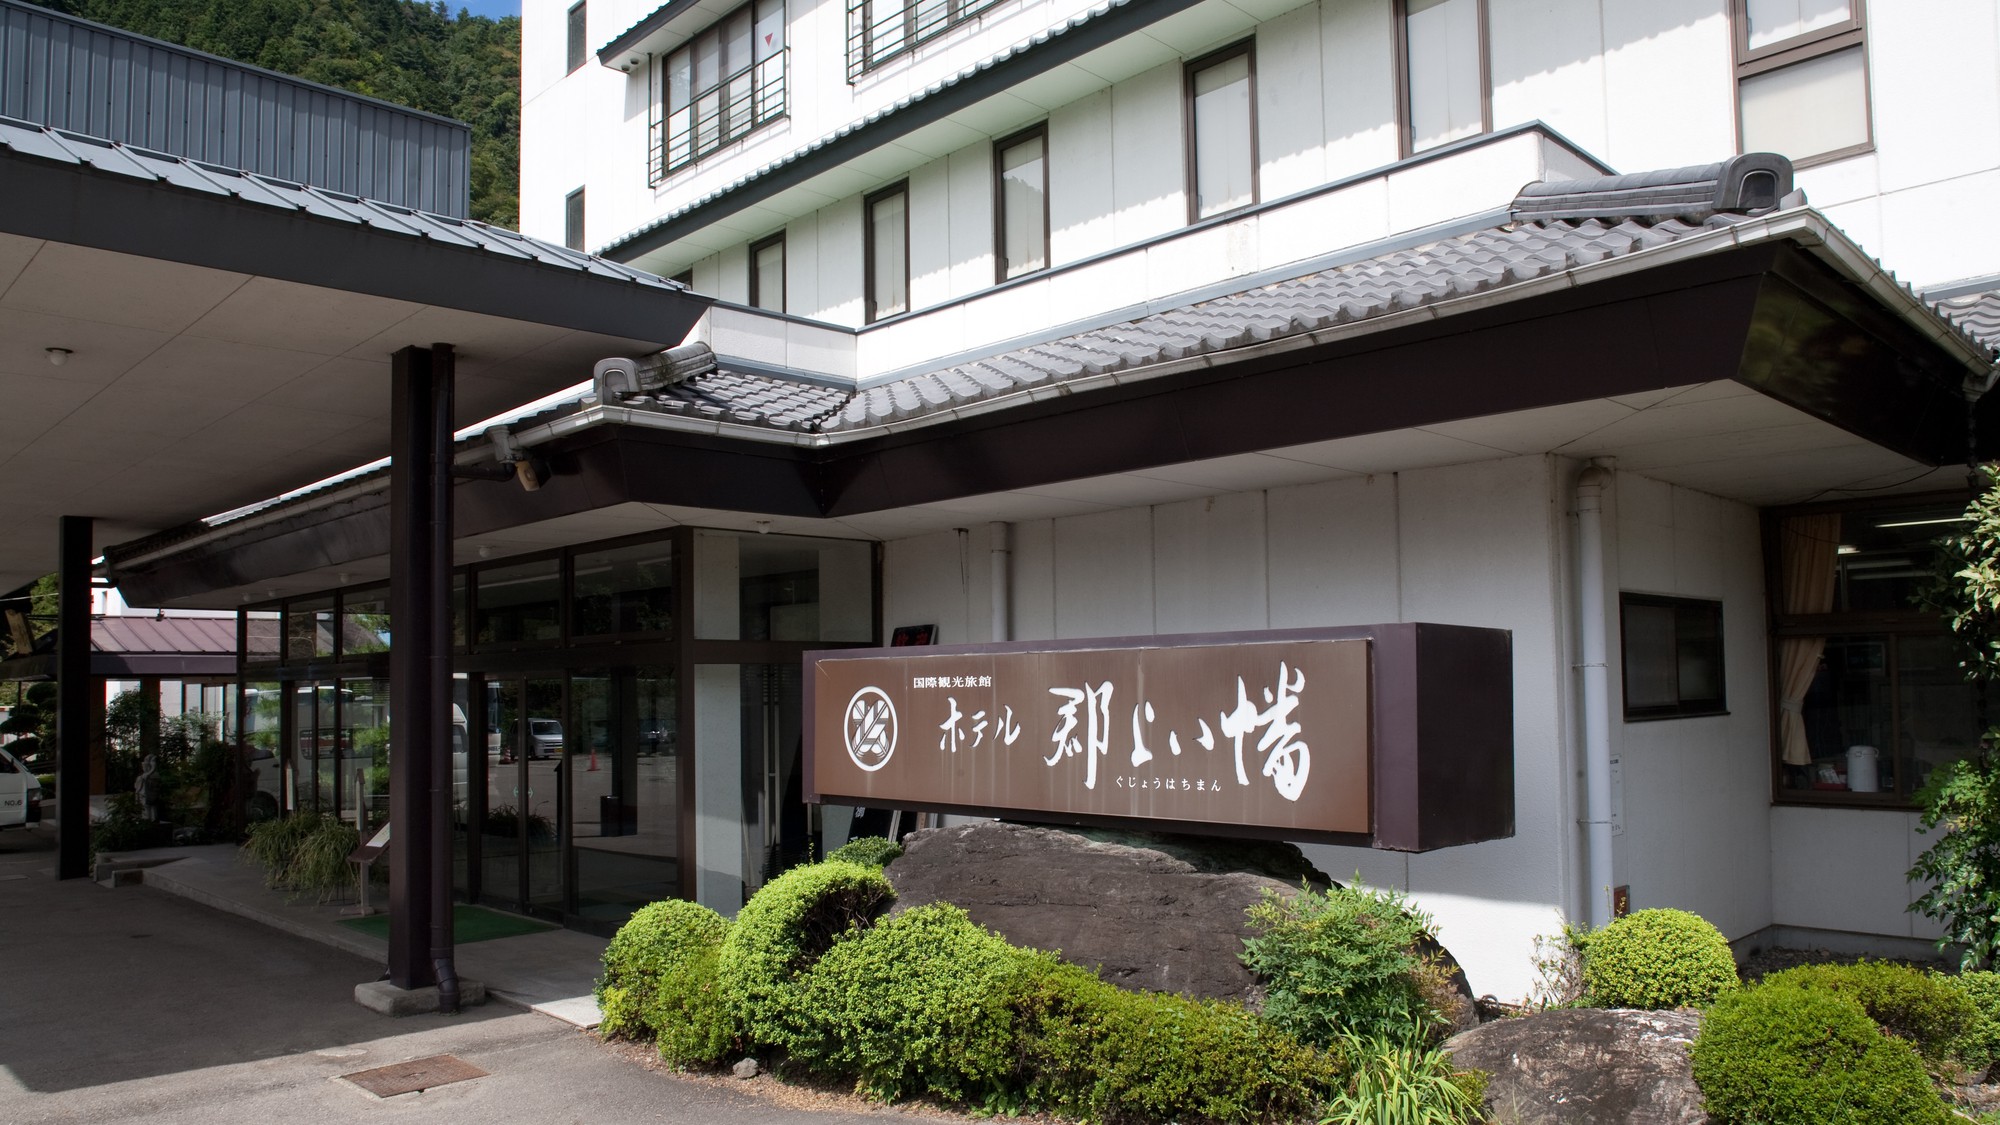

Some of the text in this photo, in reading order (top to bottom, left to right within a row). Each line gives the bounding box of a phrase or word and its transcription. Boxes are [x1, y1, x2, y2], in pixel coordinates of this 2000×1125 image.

[913, 675, 992, 689] 国際観光旅館
[939, 661, 1311, 802] ホテル 郡上八幡
[1116, 775, 1221, 792] ぐじょうはちまん
